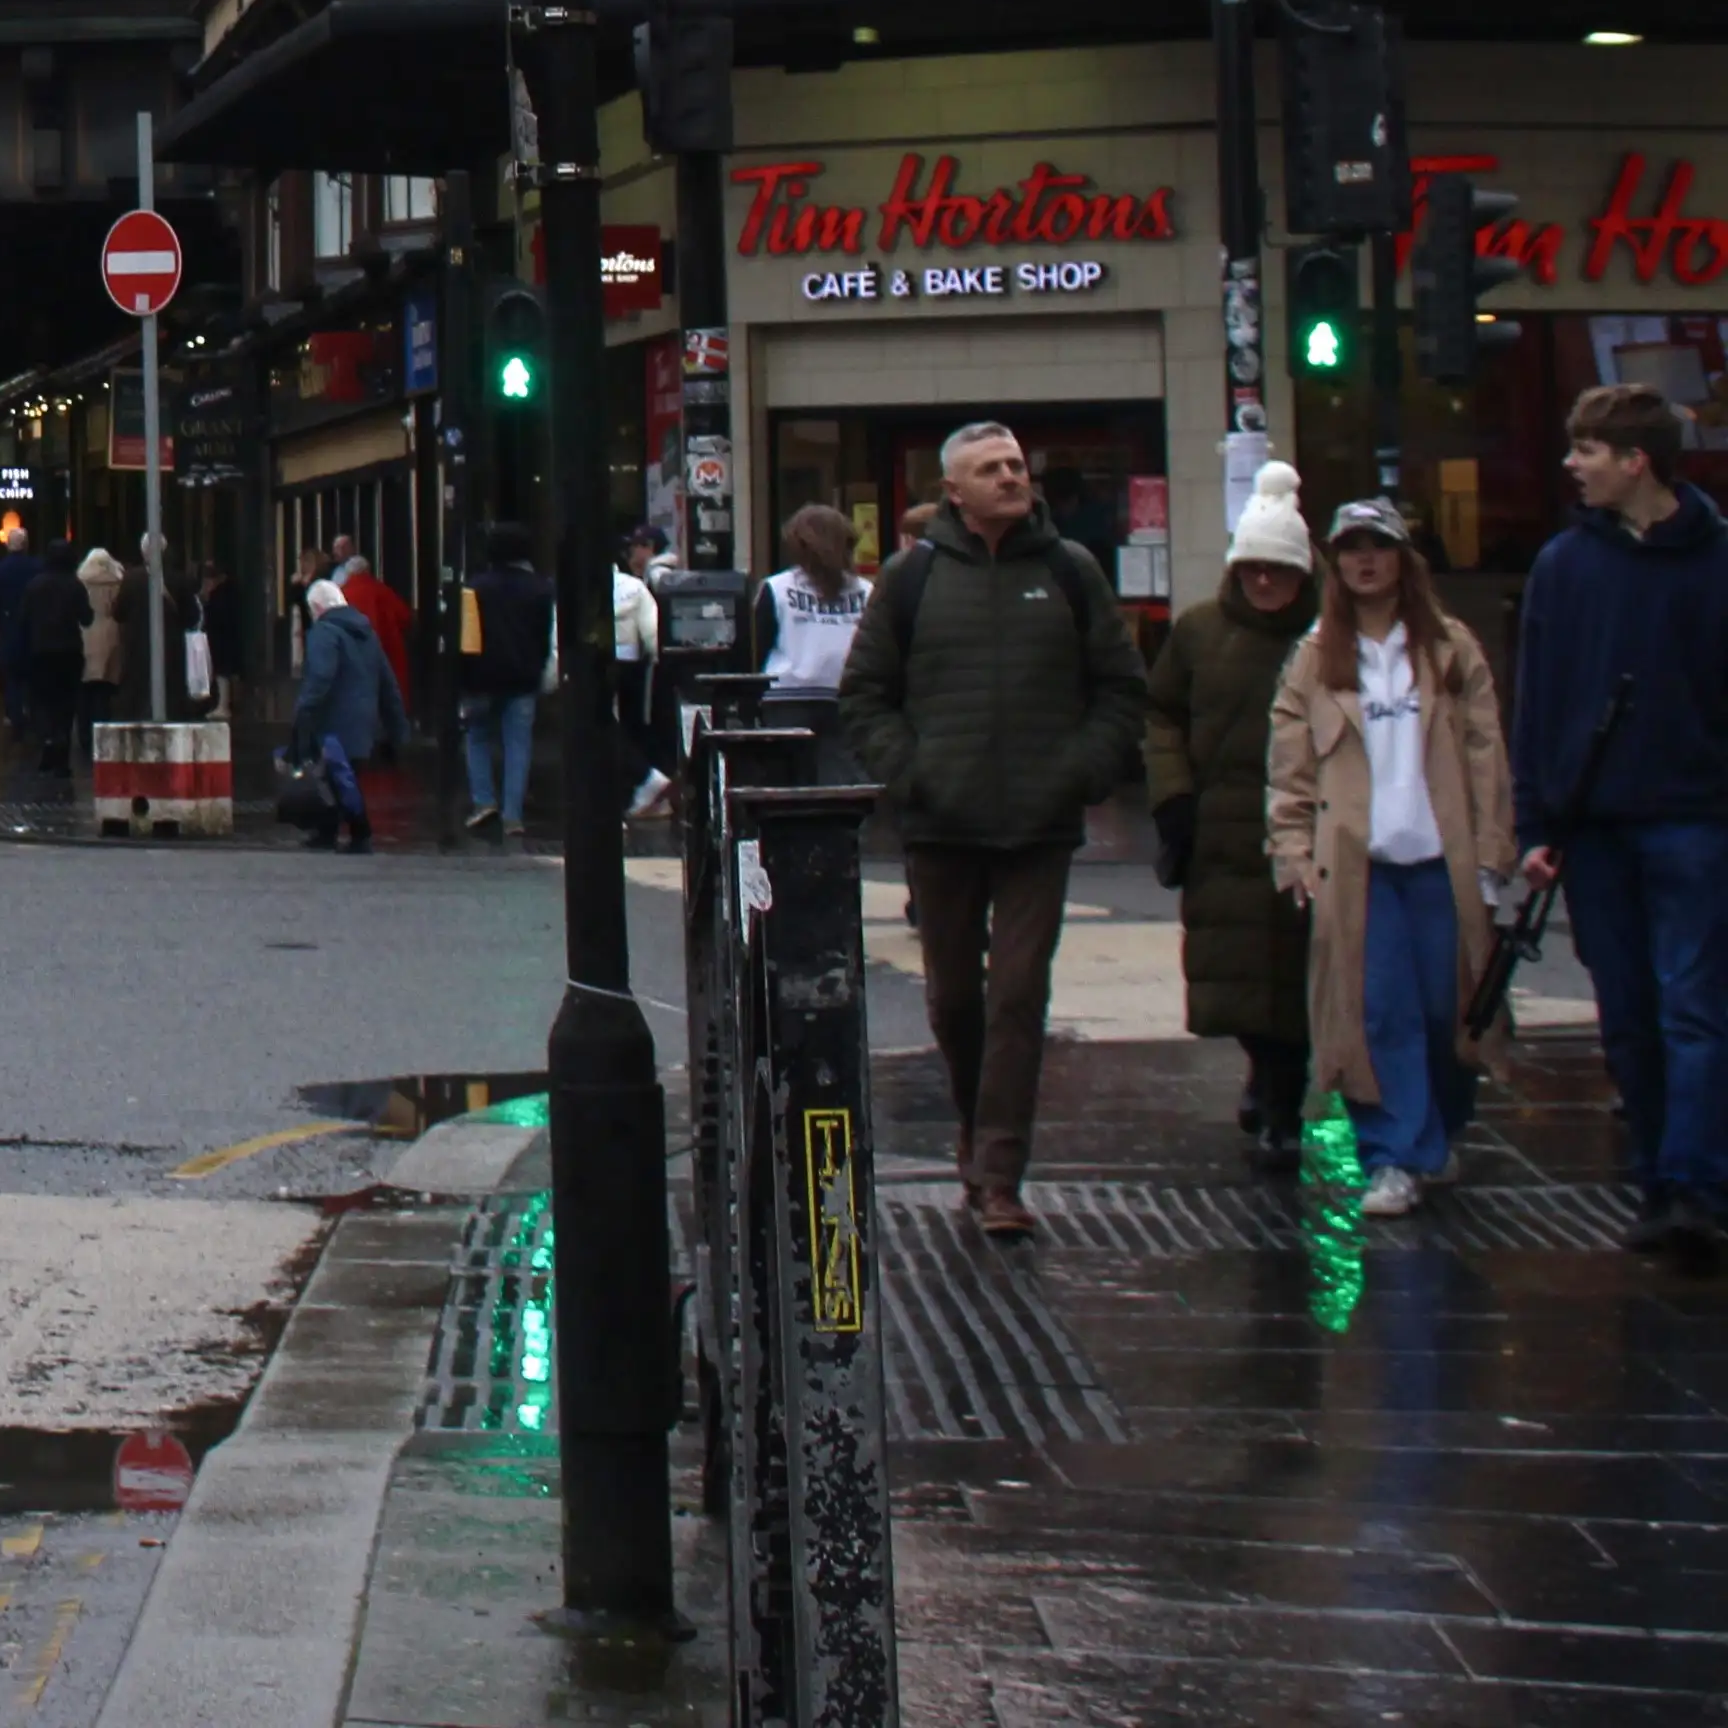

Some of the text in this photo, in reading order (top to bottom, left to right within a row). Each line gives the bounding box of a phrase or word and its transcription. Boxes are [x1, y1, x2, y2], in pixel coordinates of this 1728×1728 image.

[731, 152, 1175, 255] Tim Hortons
[889, 269, 910, 297] &
[924, 266, 1004, 295] BAKE
[1017, 261, 1102, 291] SHOP
[1, 468, 30, 480] FISH
